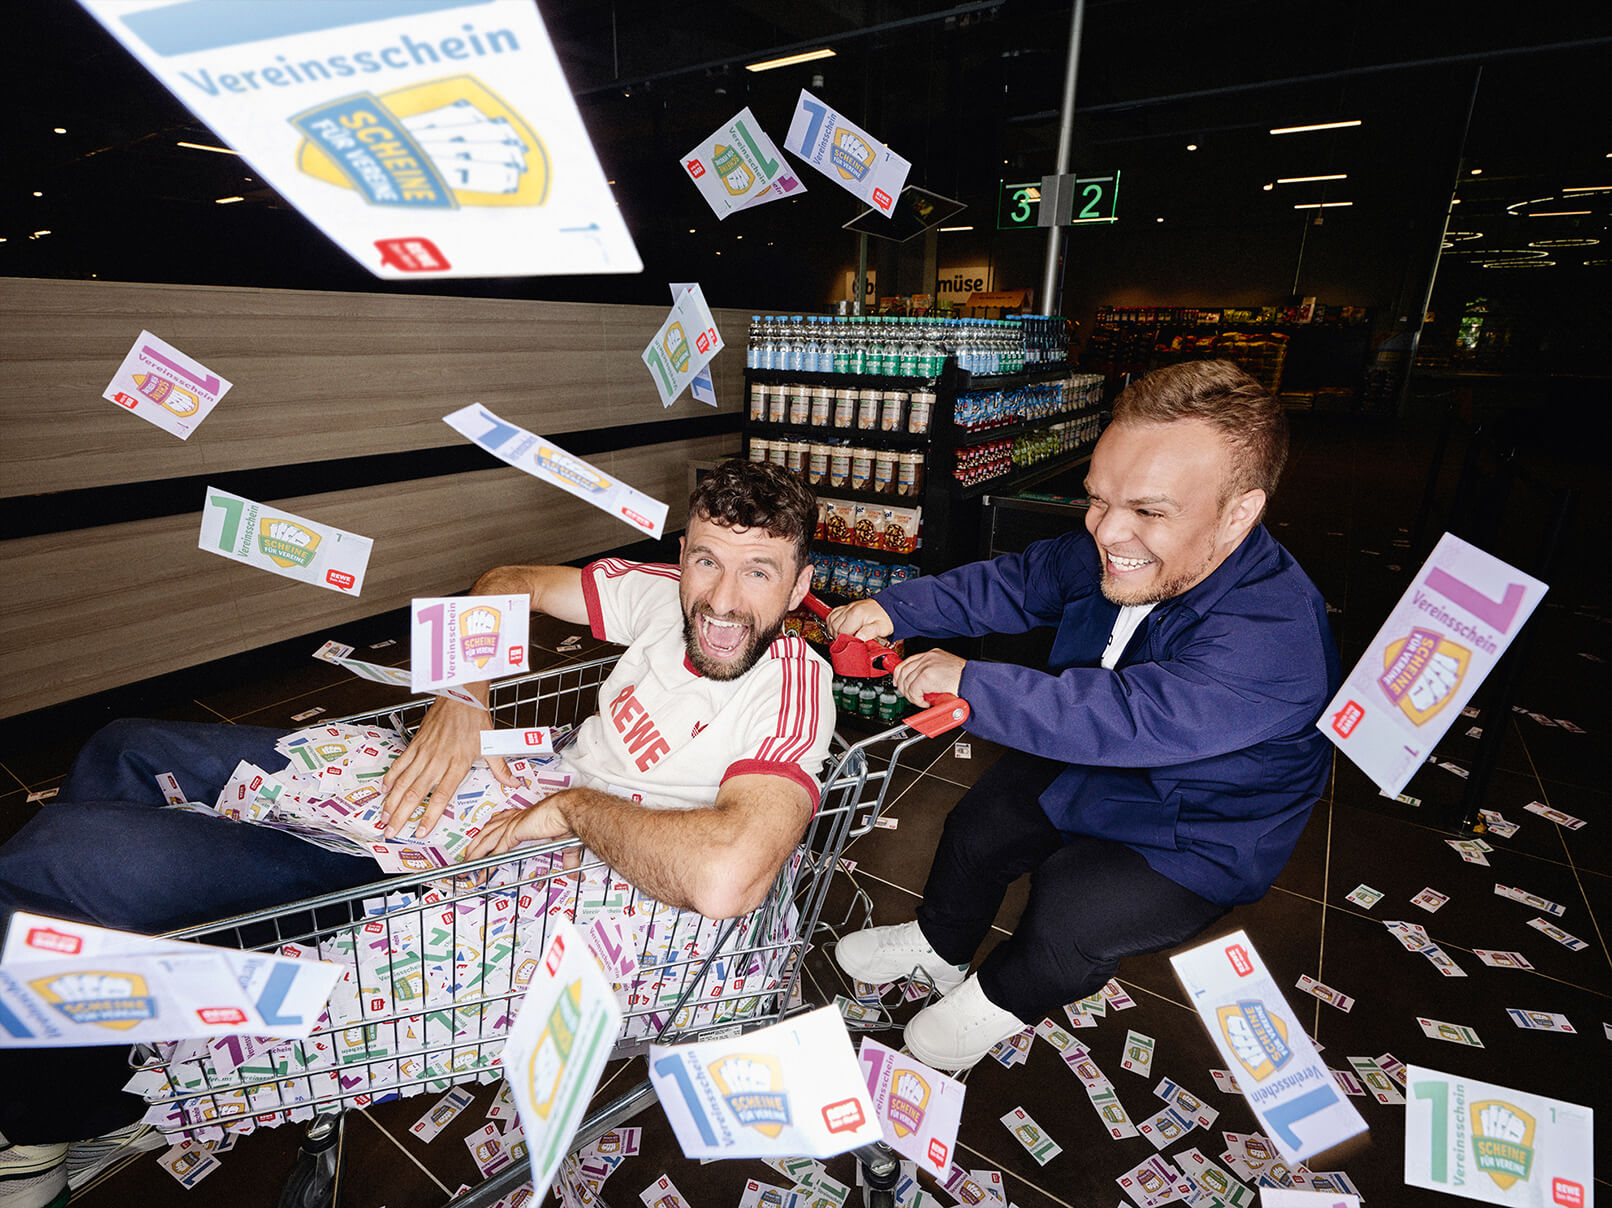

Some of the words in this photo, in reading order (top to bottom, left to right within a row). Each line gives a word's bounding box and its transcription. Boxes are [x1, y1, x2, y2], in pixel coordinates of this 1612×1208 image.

[180, 23, 522, 97] Vereinsschein
[339, 110, 436, 203] SCHEINE
[728, 127, 767, 185] Vereinsschein
[800, 100, 827, 159] 1
[812, 113, 837, 166] Vereinsschein
[311, 118, 353, 152] FÜR
[343, 147, 398, 202] VEREINE
[834, 148, 865, 174] SCHEINE
[1010, 190, 1031, 222] 3
[1079, 184, 1103, 218] 2
[937, 274, 984, 292] müse
[138, 353, 215, 403] Vereinsschein
[210, 495, 244, 553] 1
[237, 504, 260, 558] Vereinsschein
[264, 538, 309, 559] SCHEINE
[263, 546, 278, 557] FÜR
[278, 550, 305, 565] VEREINE
[330, 571, 351, 583] REWE
[1411, 590, 1498, 656] Vereinsschein
[1423, 566, 1527, 635] 1
[417, 603, 444, 682] 1
[447, 602, 457, 680] Vereinsschein
[464, 636, 497, 650] SCHEINE
[1389, 637, 1436, 696] SCHEINE
[1382, 653, 1410, 686] VEREINE
[609, 684, 671, 773] REWE
[1245, 1006, 1281, 1063] SCHEINE
[654, 1054, 719, 1147] 1
[688, 1050, 736, 1148] Vereinsschein
[731, 1095, 784, 1111] SCHEINE
[877, 1054, 895, 1120] reinsschein
[891, 1099, 920, 1123] SCHEINE
[1251, 1064, 1325, 1104] Vereinsschein
[755, 1109, 786, 1123] VEREINE
[1262, 1083, 1340, 1151] 1
[1413, 1080, 1449, 1184] 1
[1453, 1083, 1466, 1187] Vereinsschein
[1478, 1141, 1526, 1165] SCHEINE
[1479, 1155, 1496, 1169] FÜR
[1496, 1156, 1526, 1177] VEREINE
[1555, 1182, 1581, 1196] REWE
